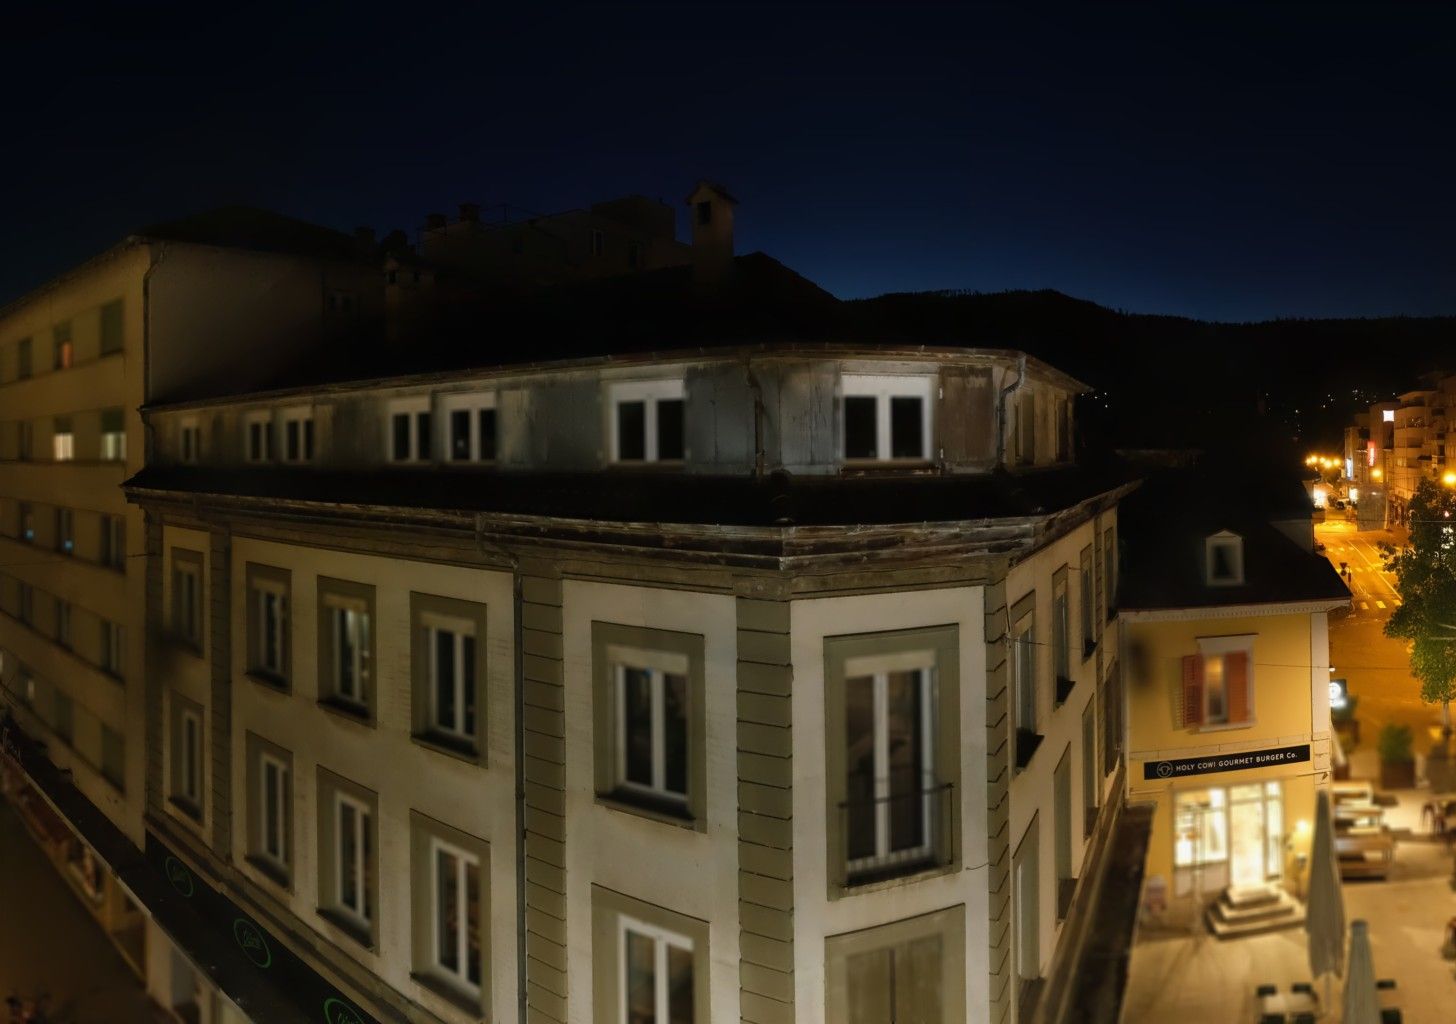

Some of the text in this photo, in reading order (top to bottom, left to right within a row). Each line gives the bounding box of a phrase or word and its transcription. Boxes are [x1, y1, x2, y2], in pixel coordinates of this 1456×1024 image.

[1176, 751, 1298, 772] HOLY COW! GOURMET BURGER Co.
